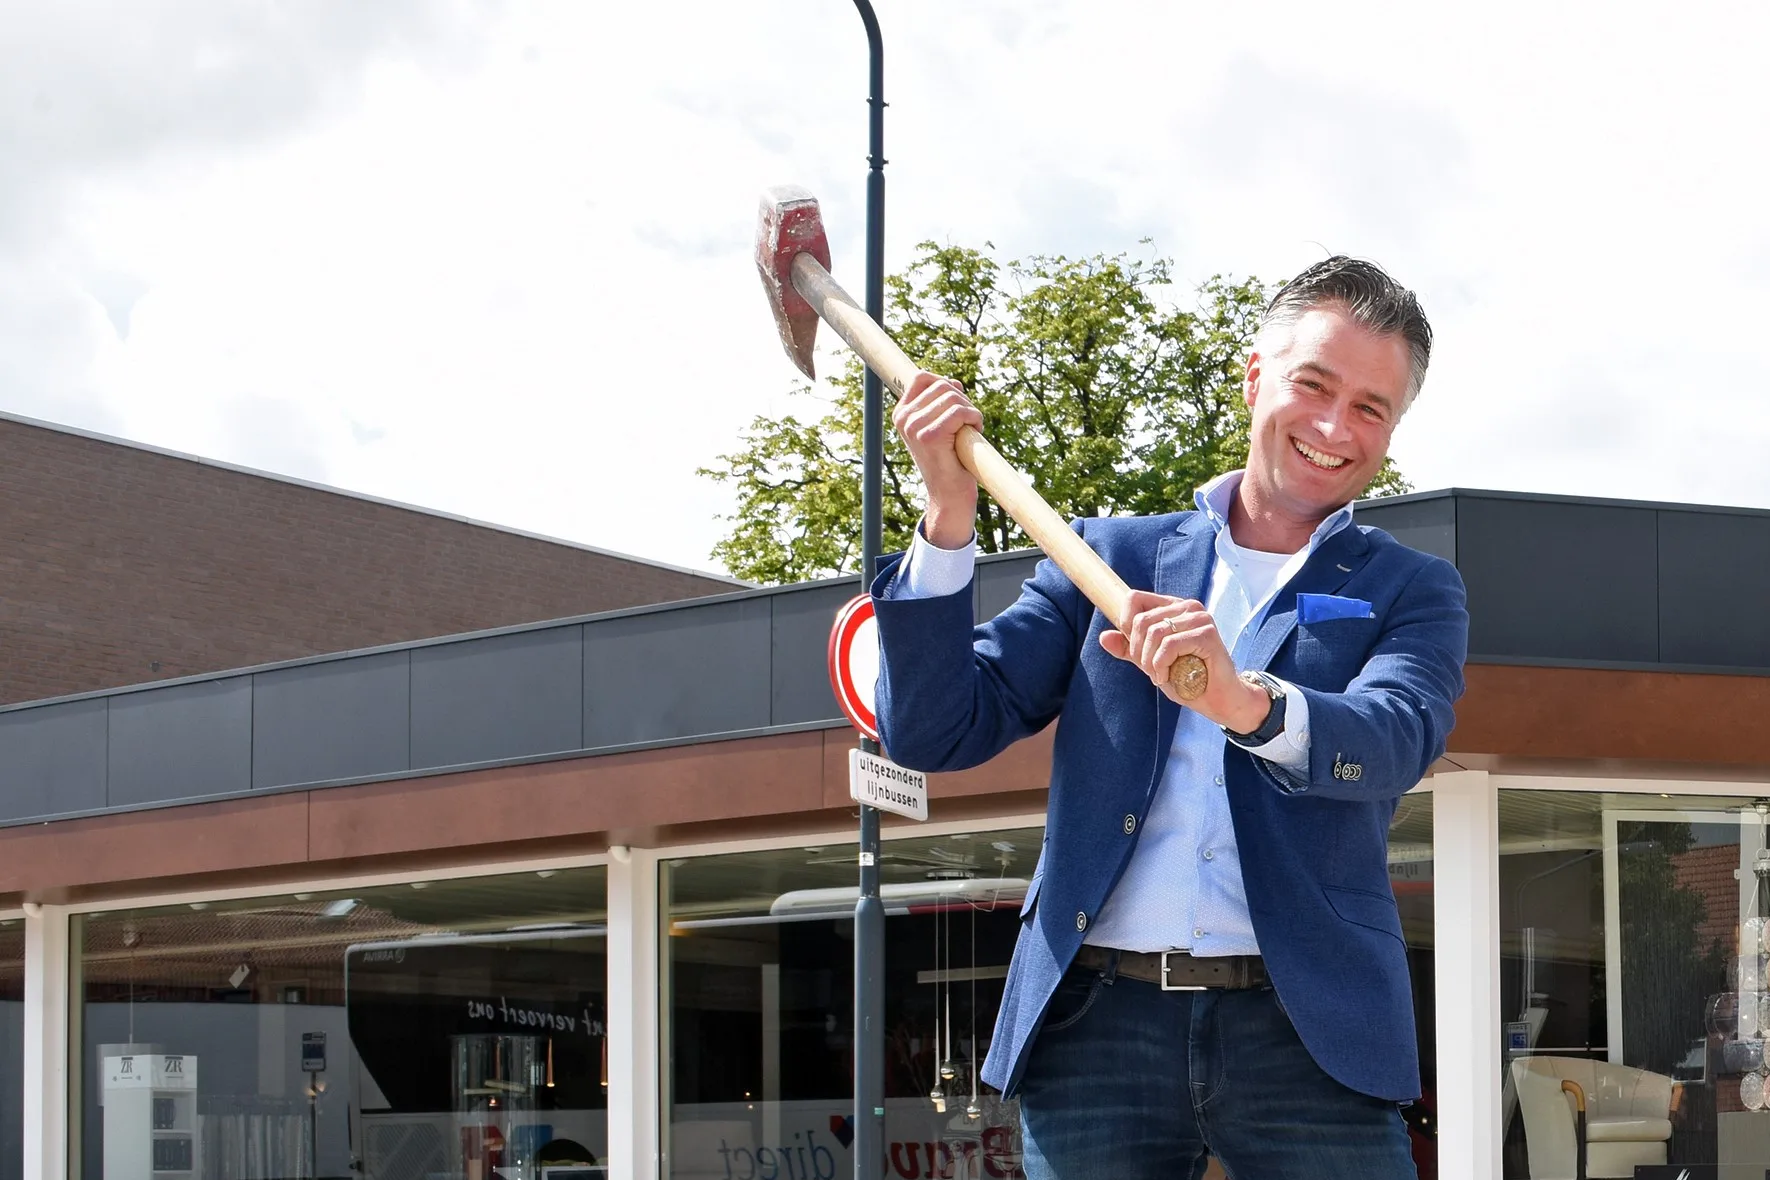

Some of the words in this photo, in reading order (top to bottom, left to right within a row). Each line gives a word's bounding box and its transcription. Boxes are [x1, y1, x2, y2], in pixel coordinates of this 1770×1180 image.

[859, 758, 923, 789] uitgezonderd
[867, 780, 918, 809] lijnbussen
[165, 1060, 183, 1073] ZR
